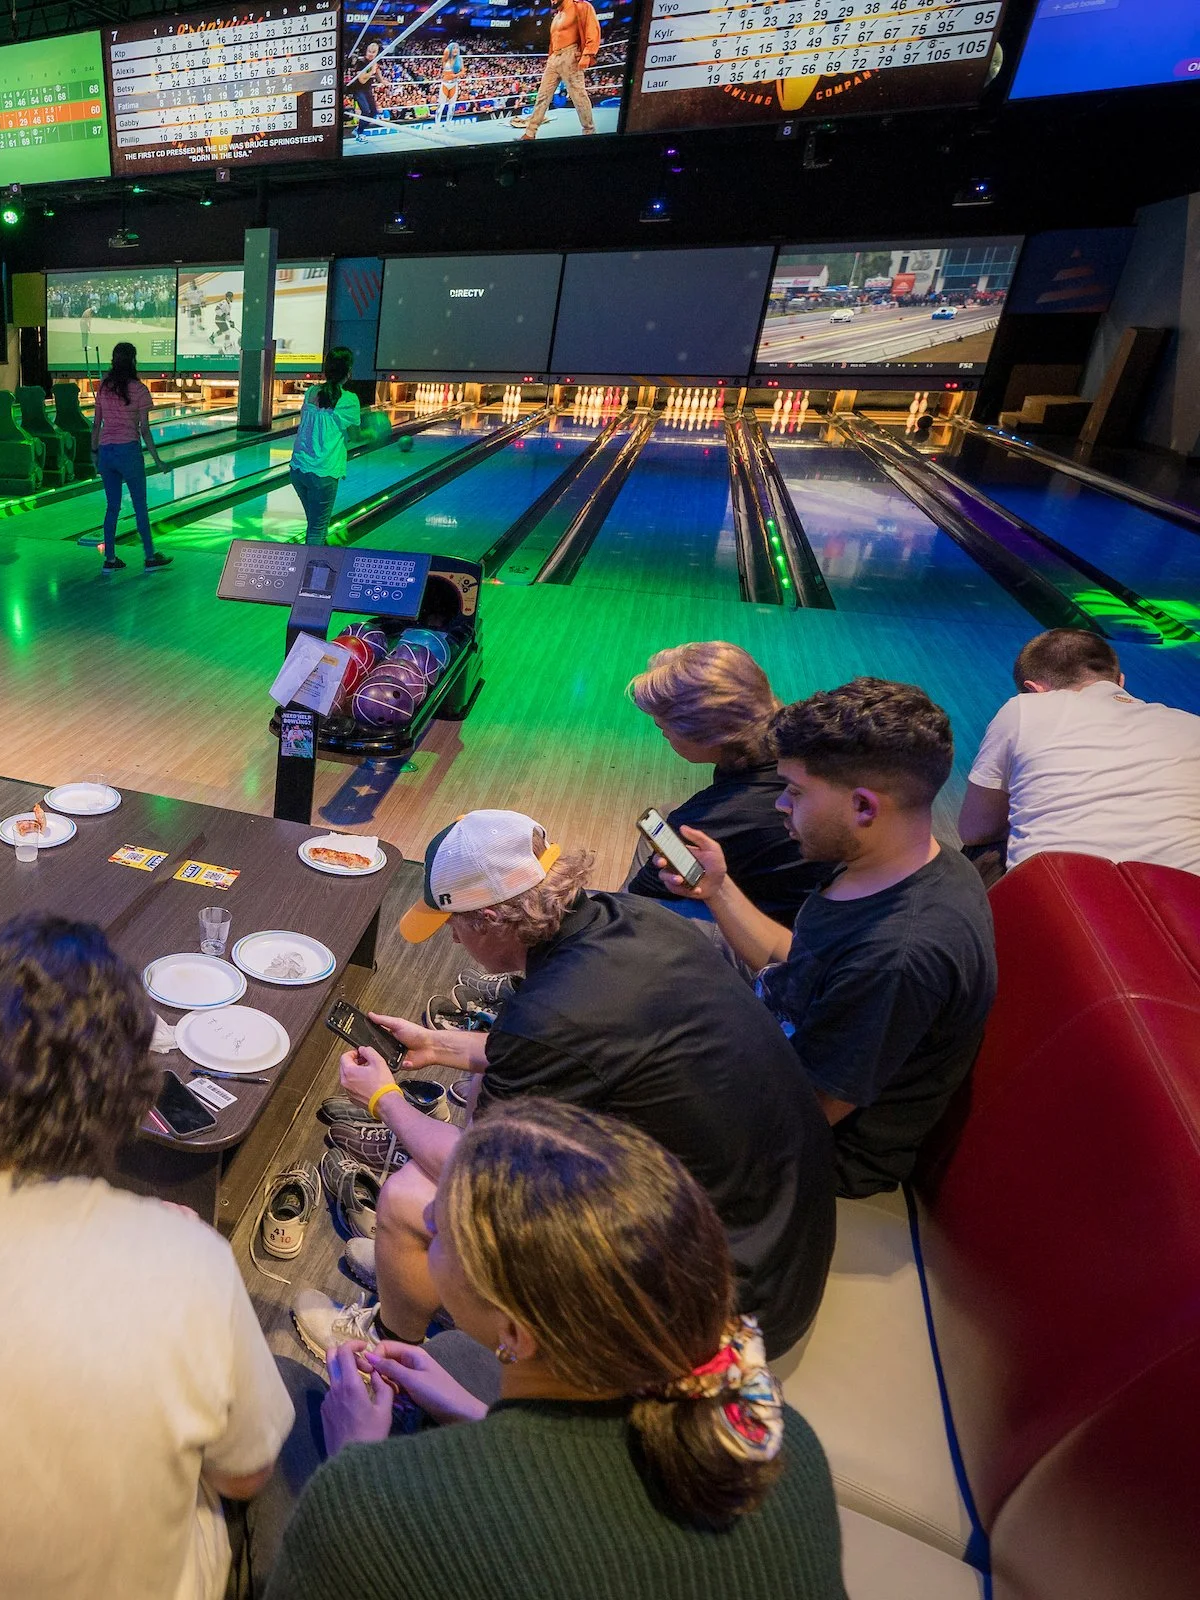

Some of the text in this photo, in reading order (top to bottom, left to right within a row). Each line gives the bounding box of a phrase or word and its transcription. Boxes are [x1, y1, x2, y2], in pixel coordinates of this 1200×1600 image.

[659, 3, 678, 12] Yiyo
[322, 16, 333, 27] 41
[654, 3, 880, 39] Kylr 7 15 23 23 29 29 38
[111, 31, 118, 41] 7
[650, 11, 996, 64] Omar 8 15 15 33 49 57 67 67 75 95 95
[265, 48, 277, 56] 102
[316, 36, 333, 47] 131
[321, 56, 333, 66] 88
[647, 40, 987, 89] Laur 19 35 41 47 56 69 72 79 97 105 105
[89, 85, 99, 94] 68
[719, 68, 880, 105] OWLING COMPAN
[118, 102, 139, 110] Fatima
[320, 75, 333, 86] 46
[91, 105, 100, 114] 60
[120, 120, 139, 128] Gabby
[320, 94, 332, 104] 45
[320, 113, 332, 123] 92
[93, 126, 101, 135] 87
[783, 126, 792, 135] 8
[138, 151, 155, 159] FIRST
[166, 147, 196, 156] PRESSED
[229, 141, 244, 149] WAS
[245, 139, 268, 148] BRUCE
[269, 135, 324, 146] SPRINGSTEEN'S
[189, 154, 210, 162] "BORN
[234, 150, 252, 158] USA."
[449, 288, 485, 298] DIRECTV
[439, 894, 451, 906] R
